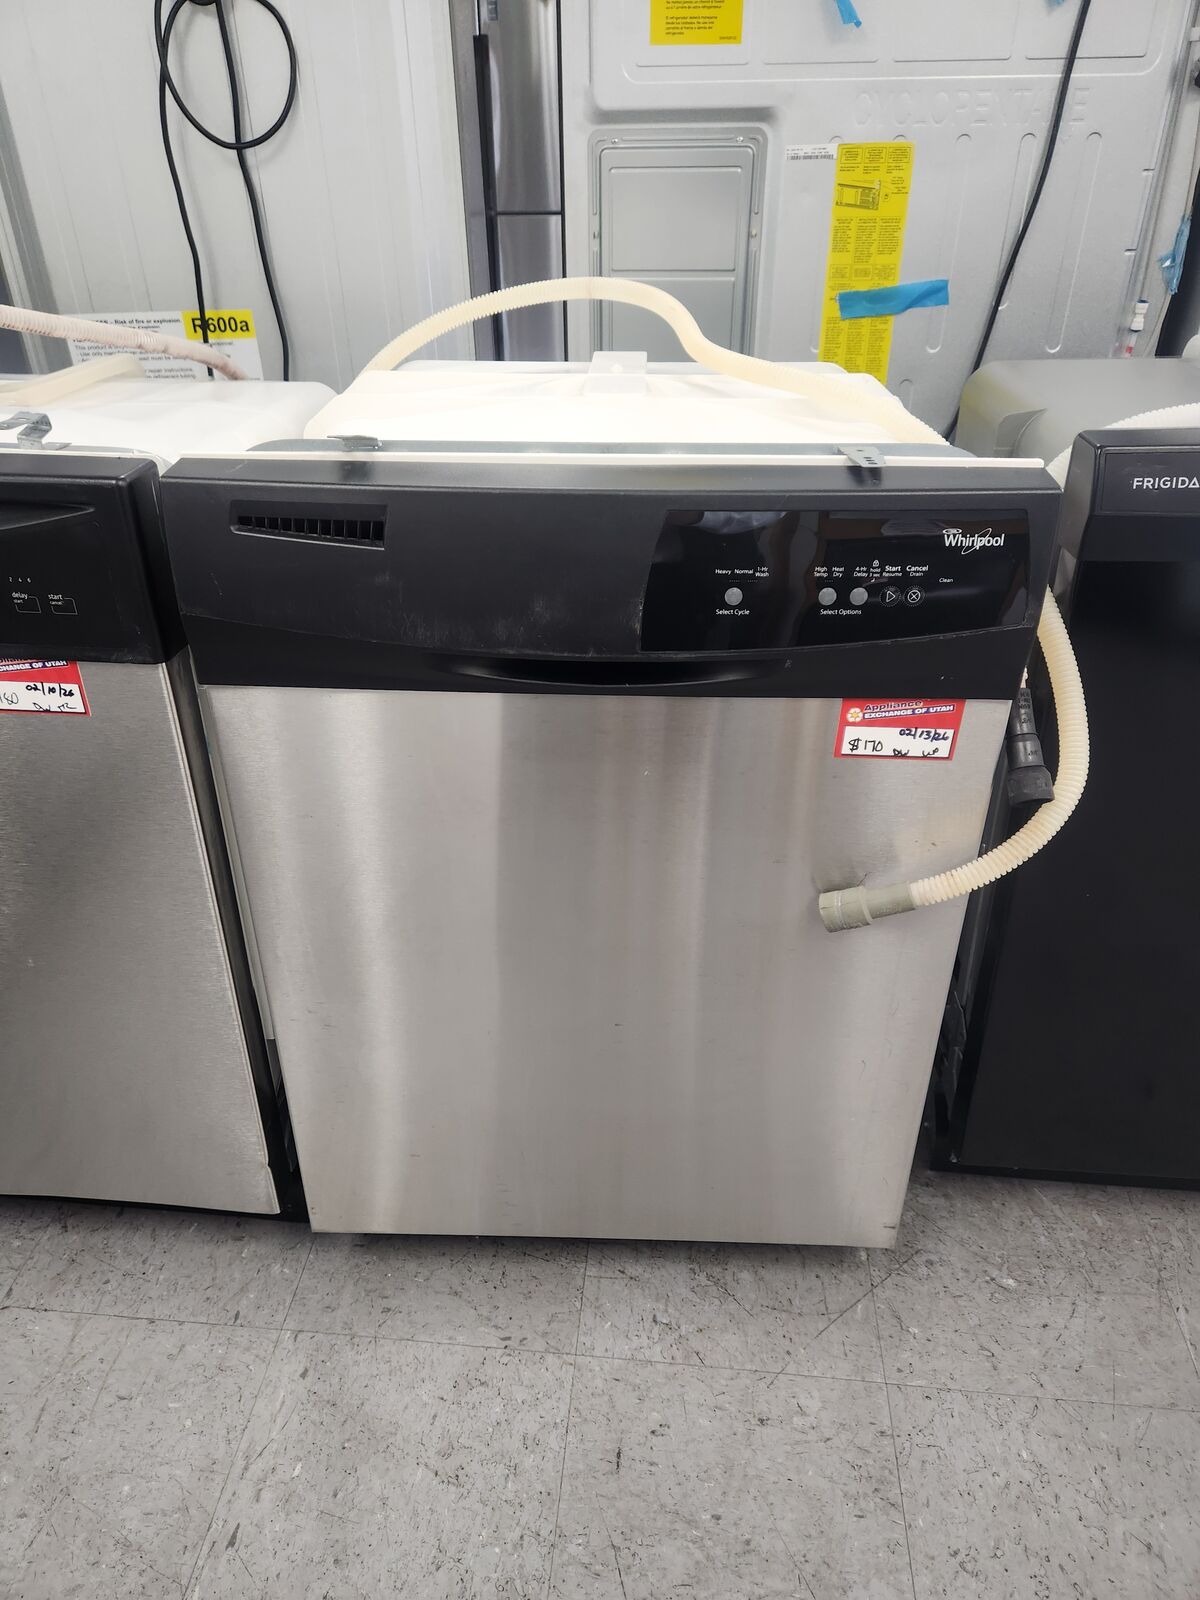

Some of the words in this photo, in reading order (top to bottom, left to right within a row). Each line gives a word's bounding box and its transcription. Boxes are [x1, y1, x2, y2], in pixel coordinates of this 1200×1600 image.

[191, 316, 250, 334] R600a
[1132, 476, 1200, 490] FRIGIDA
[943, 530, 1005, 552] Whirlpool
[715, 568, 732, 576] Heavy
[12, 592, 28, 600] delay
[734, 608, 750, 616] Cycle
[838, 608, 862, 616] Options
[864, 700, 922, 712] Appliance
[864, 708, 913, 719] EXCHANGE
[915, 706, 928, 714] OF
[930, 704, 954, 713] UTAH
[848, 737, 884, 752] $170
